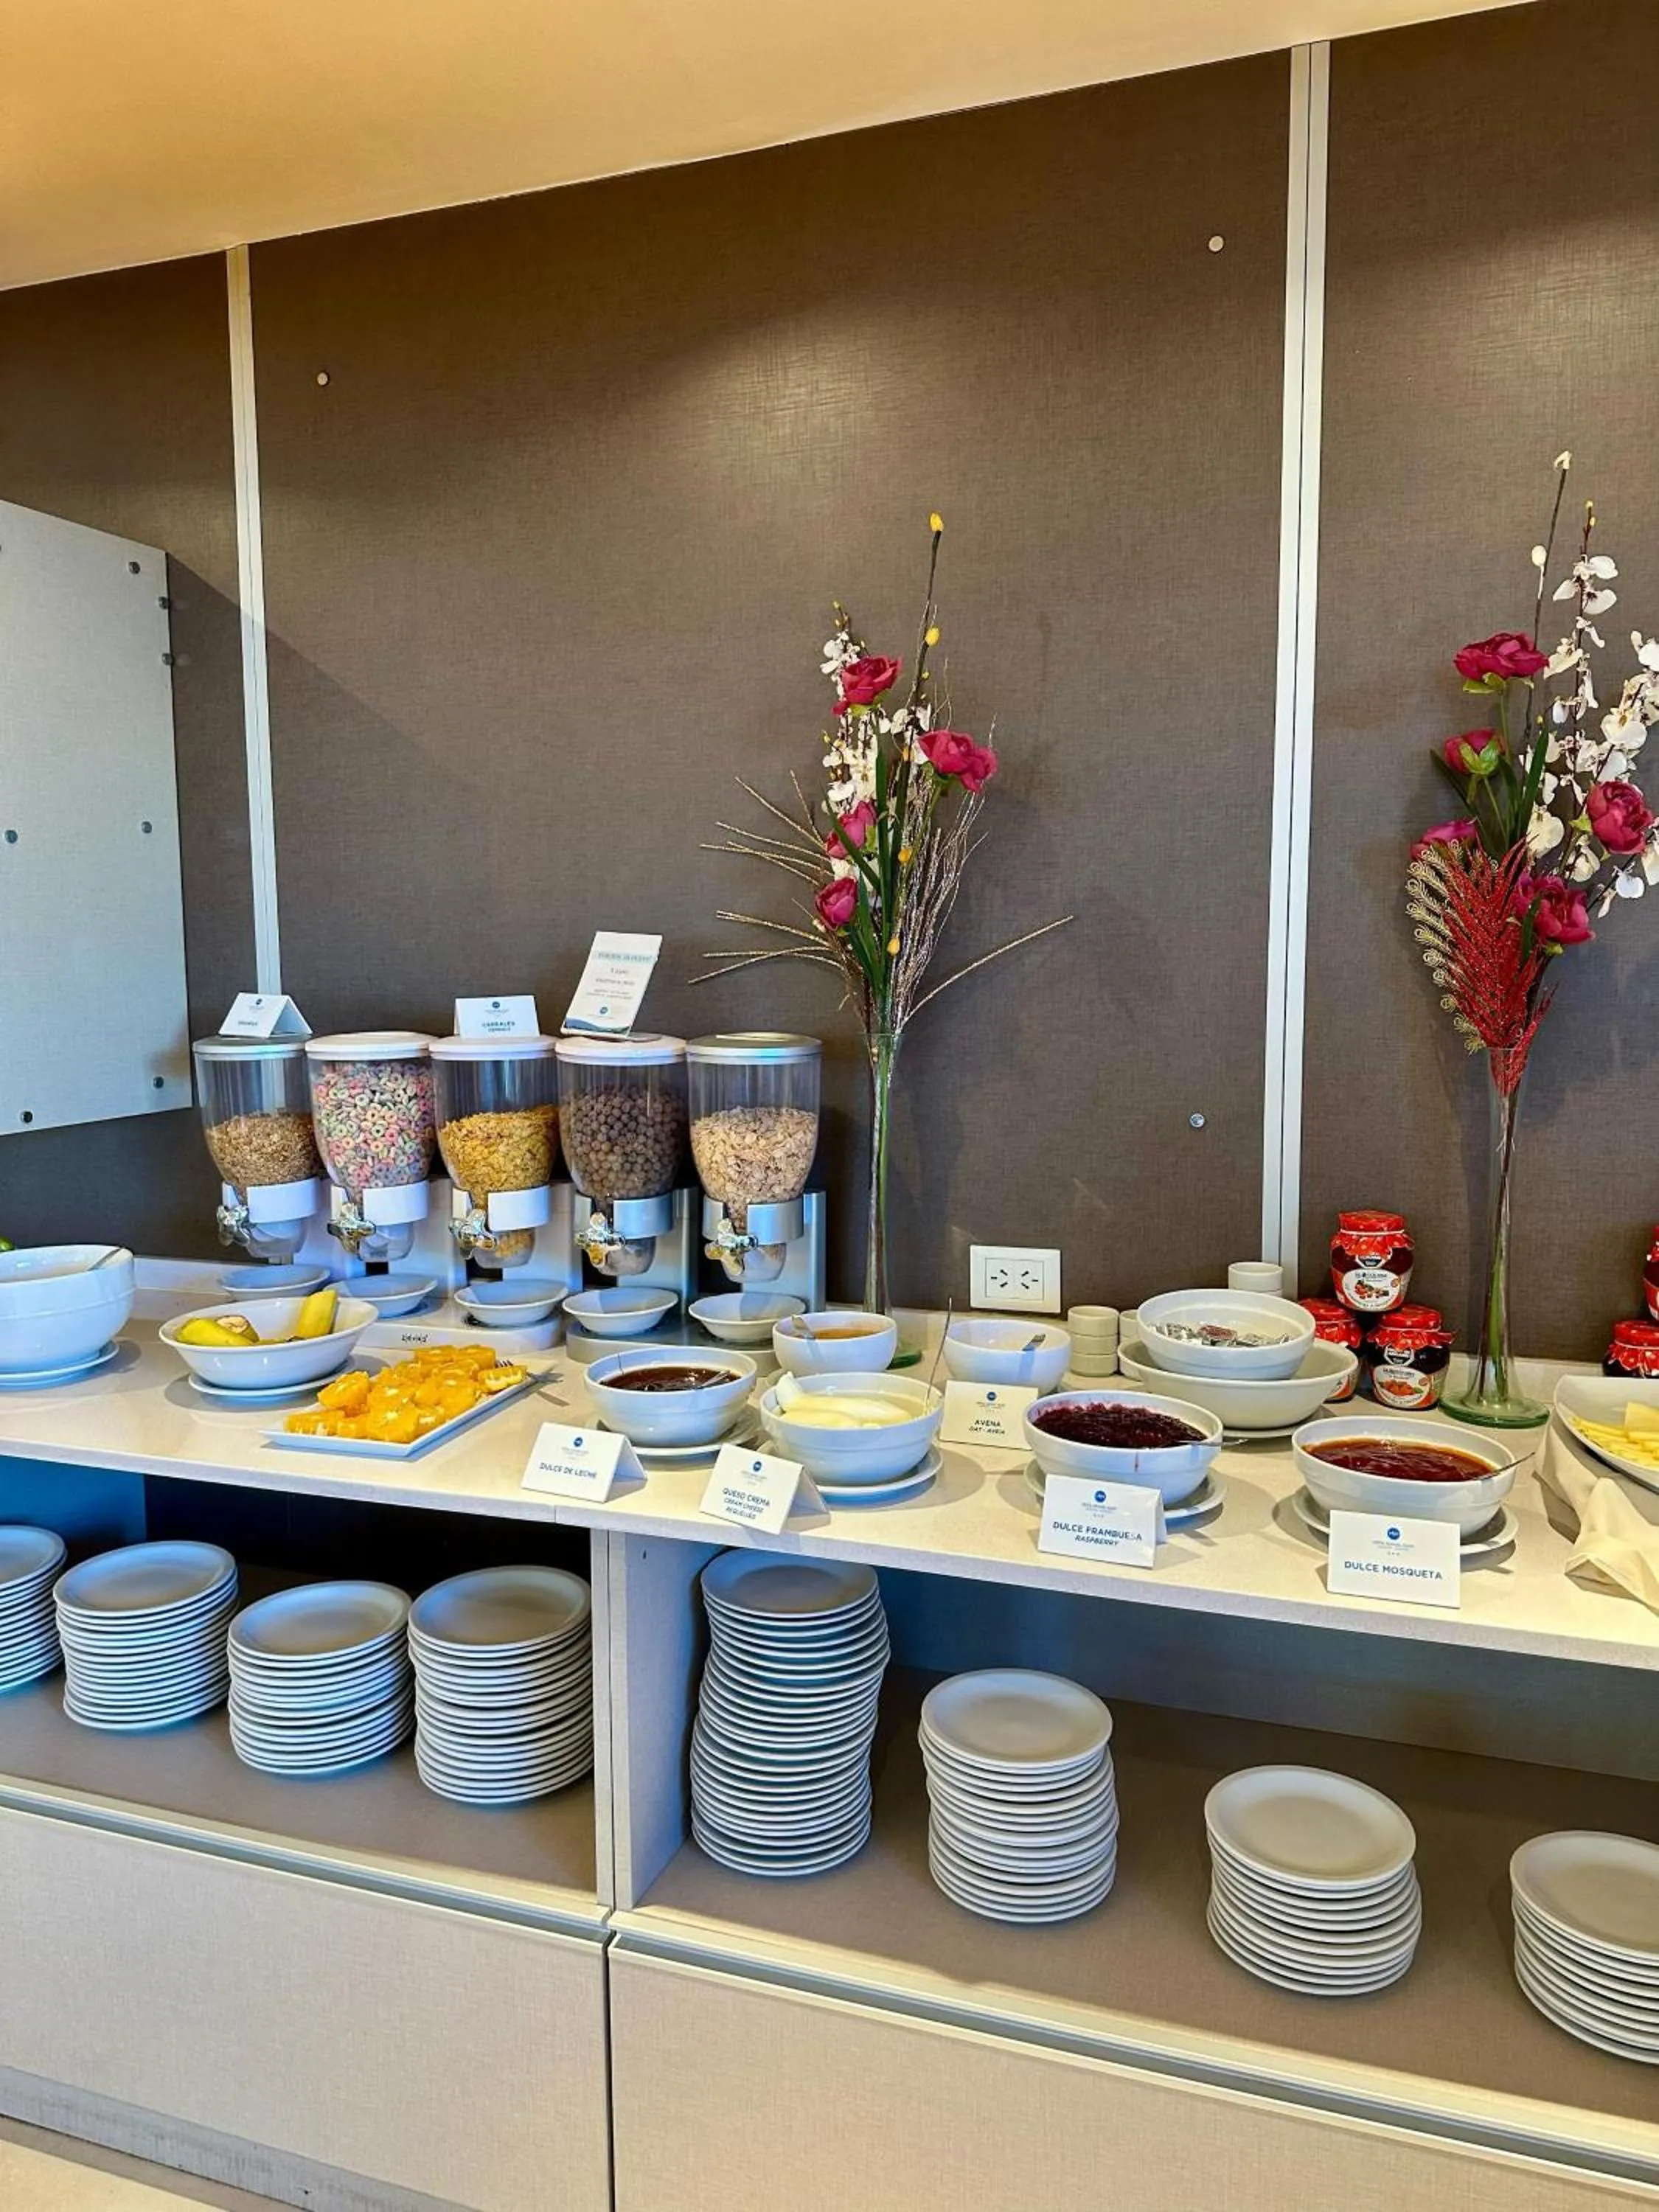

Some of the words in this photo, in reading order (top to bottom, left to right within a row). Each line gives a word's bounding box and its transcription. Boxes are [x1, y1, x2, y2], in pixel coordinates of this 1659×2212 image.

[540, 1461, 563, 1473] DULCE
[563, 1467, 574, 1475] DE
[574, 1467, 597, 1479] LECHE
[722, 1487, 745, 1500] QUESO
[747, 1494, 771, 1506] CREMA
[1052, 1521, 1083, 1534] DULCE
[1074, 1534, 1119, 1547] RASPBERRY
[1344, 1560, 1380, 1573] DULCE
[1382, 1565, 1443, 1580] MOSQUETA
